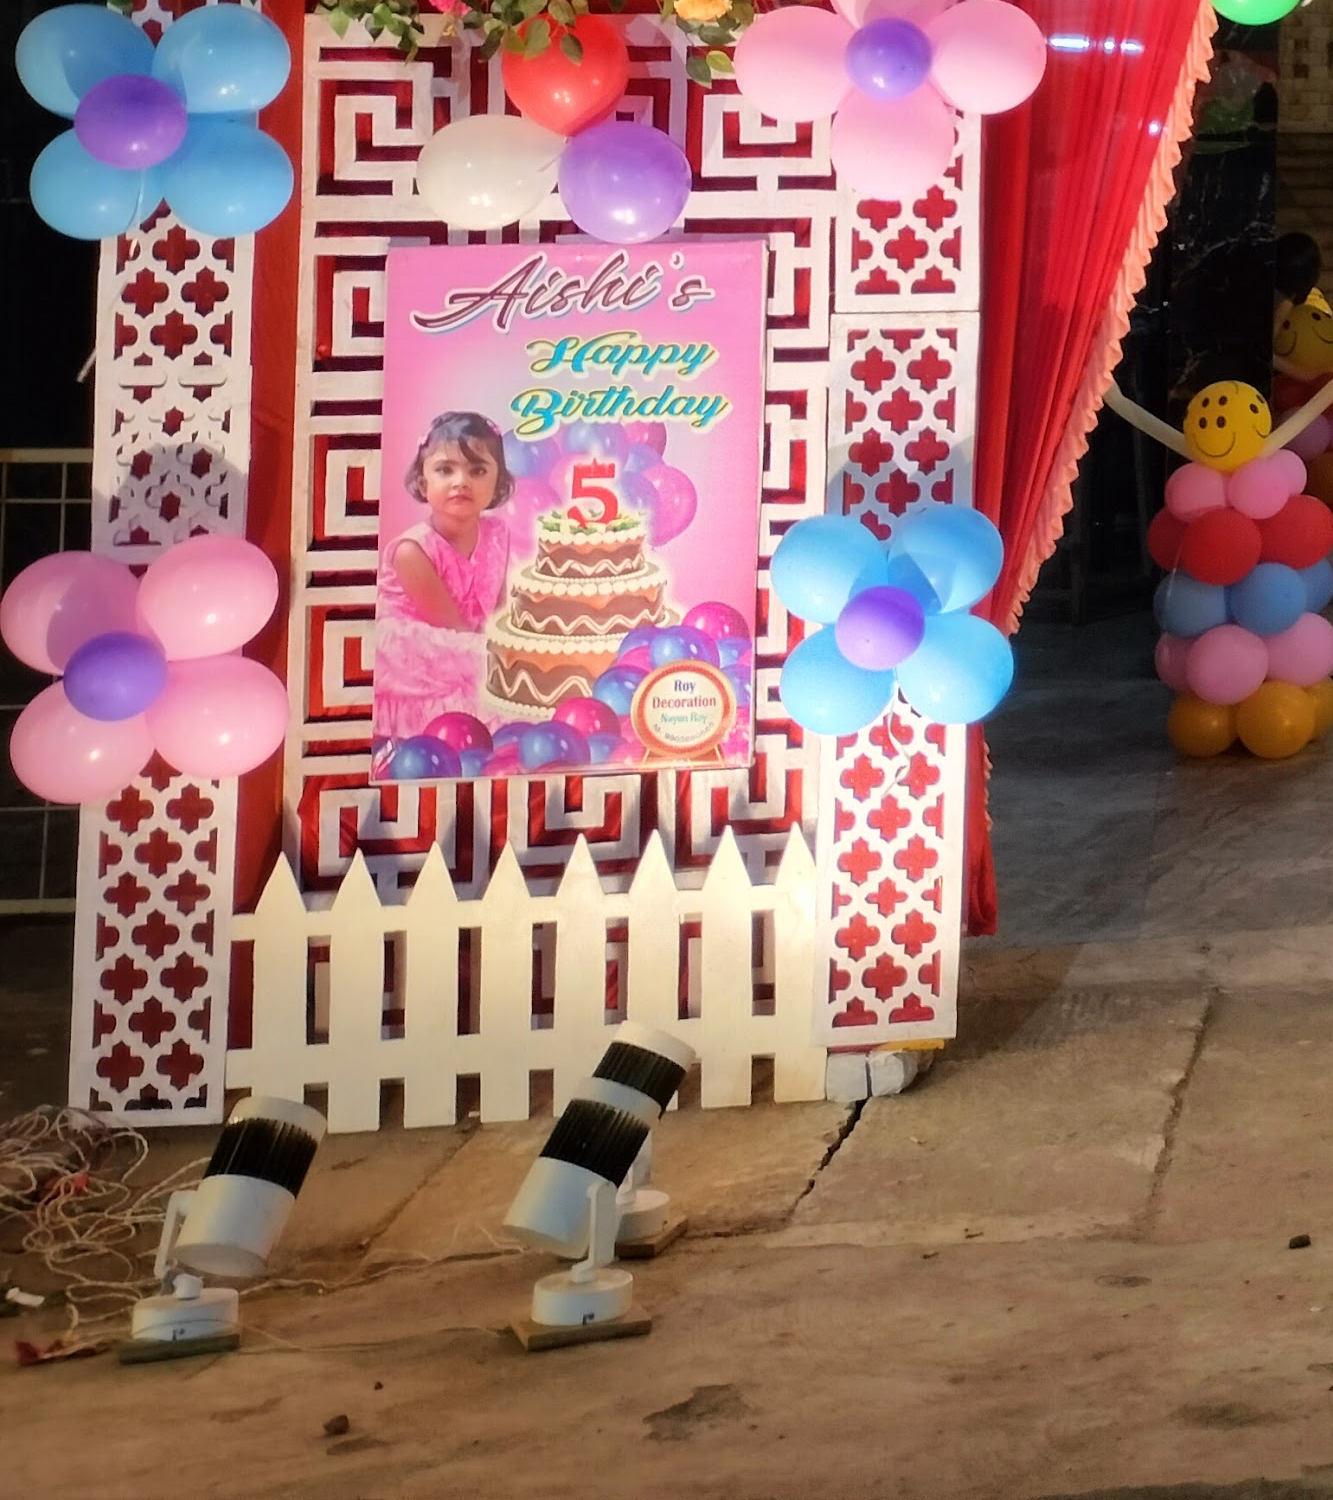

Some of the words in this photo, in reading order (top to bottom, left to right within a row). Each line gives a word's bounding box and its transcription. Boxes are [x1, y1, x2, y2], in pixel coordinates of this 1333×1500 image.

[414, 254, 712, 330] Aishi's
[527, 333, 716, 375] Happy
[511, 385, 729, 436] Birthday
[568, 460, 619, 528] 5
[652, 695, 716, 709] Decoration
[674, 680, 696, 693] Roy
